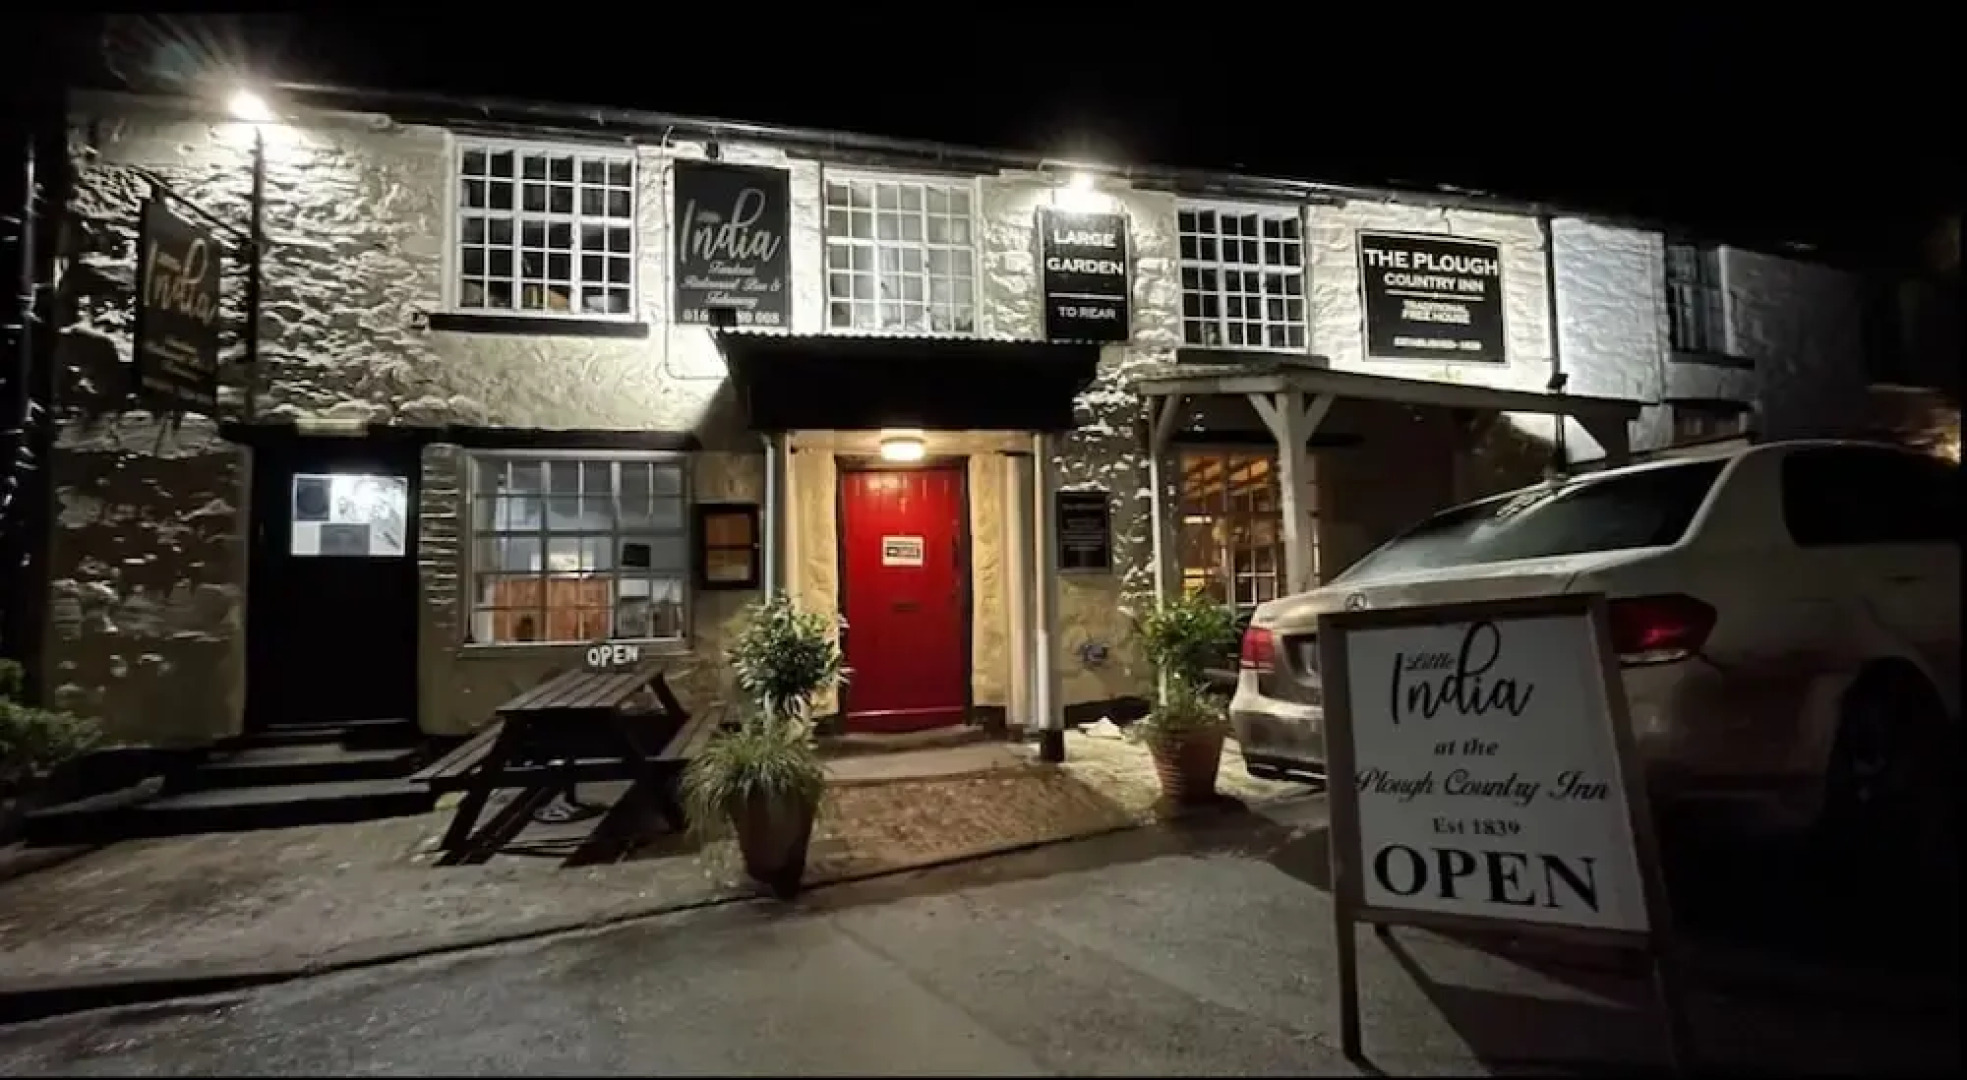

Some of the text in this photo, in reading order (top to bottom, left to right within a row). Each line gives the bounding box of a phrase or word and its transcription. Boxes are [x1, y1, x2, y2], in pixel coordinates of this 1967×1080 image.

[680, 188, 782, 264] India
[1053, 230, 1117, 247] LARGE
[1047, 257, 1124, 275] GARDEN
[1365, 248, 1498, 276] THE PLOUGH
[1384, 273, 1484, 293] COUNTRY INN
[1057, 306, 1116, 320] TO REAR
[587, 645, 638, 667] OPEN
[1391, 621, 1535, 725] India
[1433, 737, 1500, 756] at the
[1354, 767, 1609, 808] Plough Country Inn
[1432, 817, 1522, 836] Est 1839
[1373, 844, 1600, 914] OPEN
